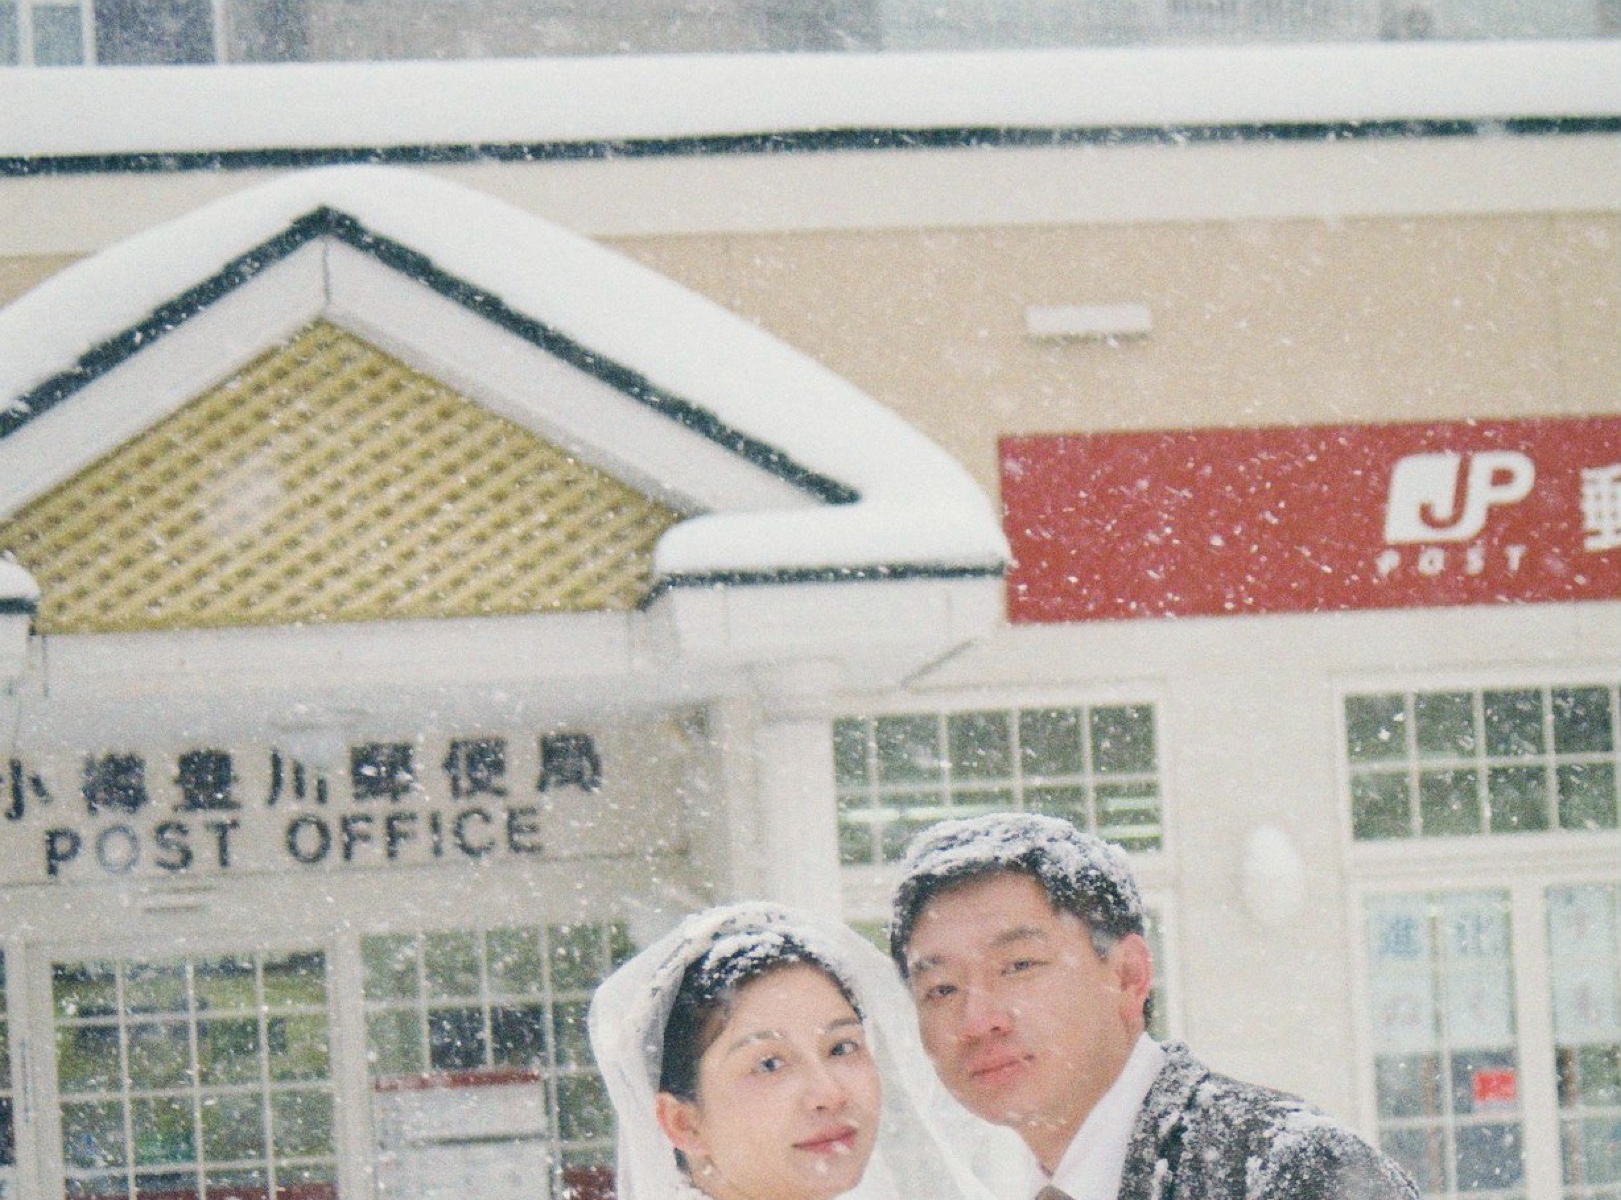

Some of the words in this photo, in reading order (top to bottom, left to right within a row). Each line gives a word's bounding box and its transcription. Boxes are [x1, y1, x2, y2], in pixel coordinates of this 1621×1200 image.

[1383, 451, 1535, 545] JP
[45, 819, 240, 876] POST
[286, 806, 544, 864] OFFICE
